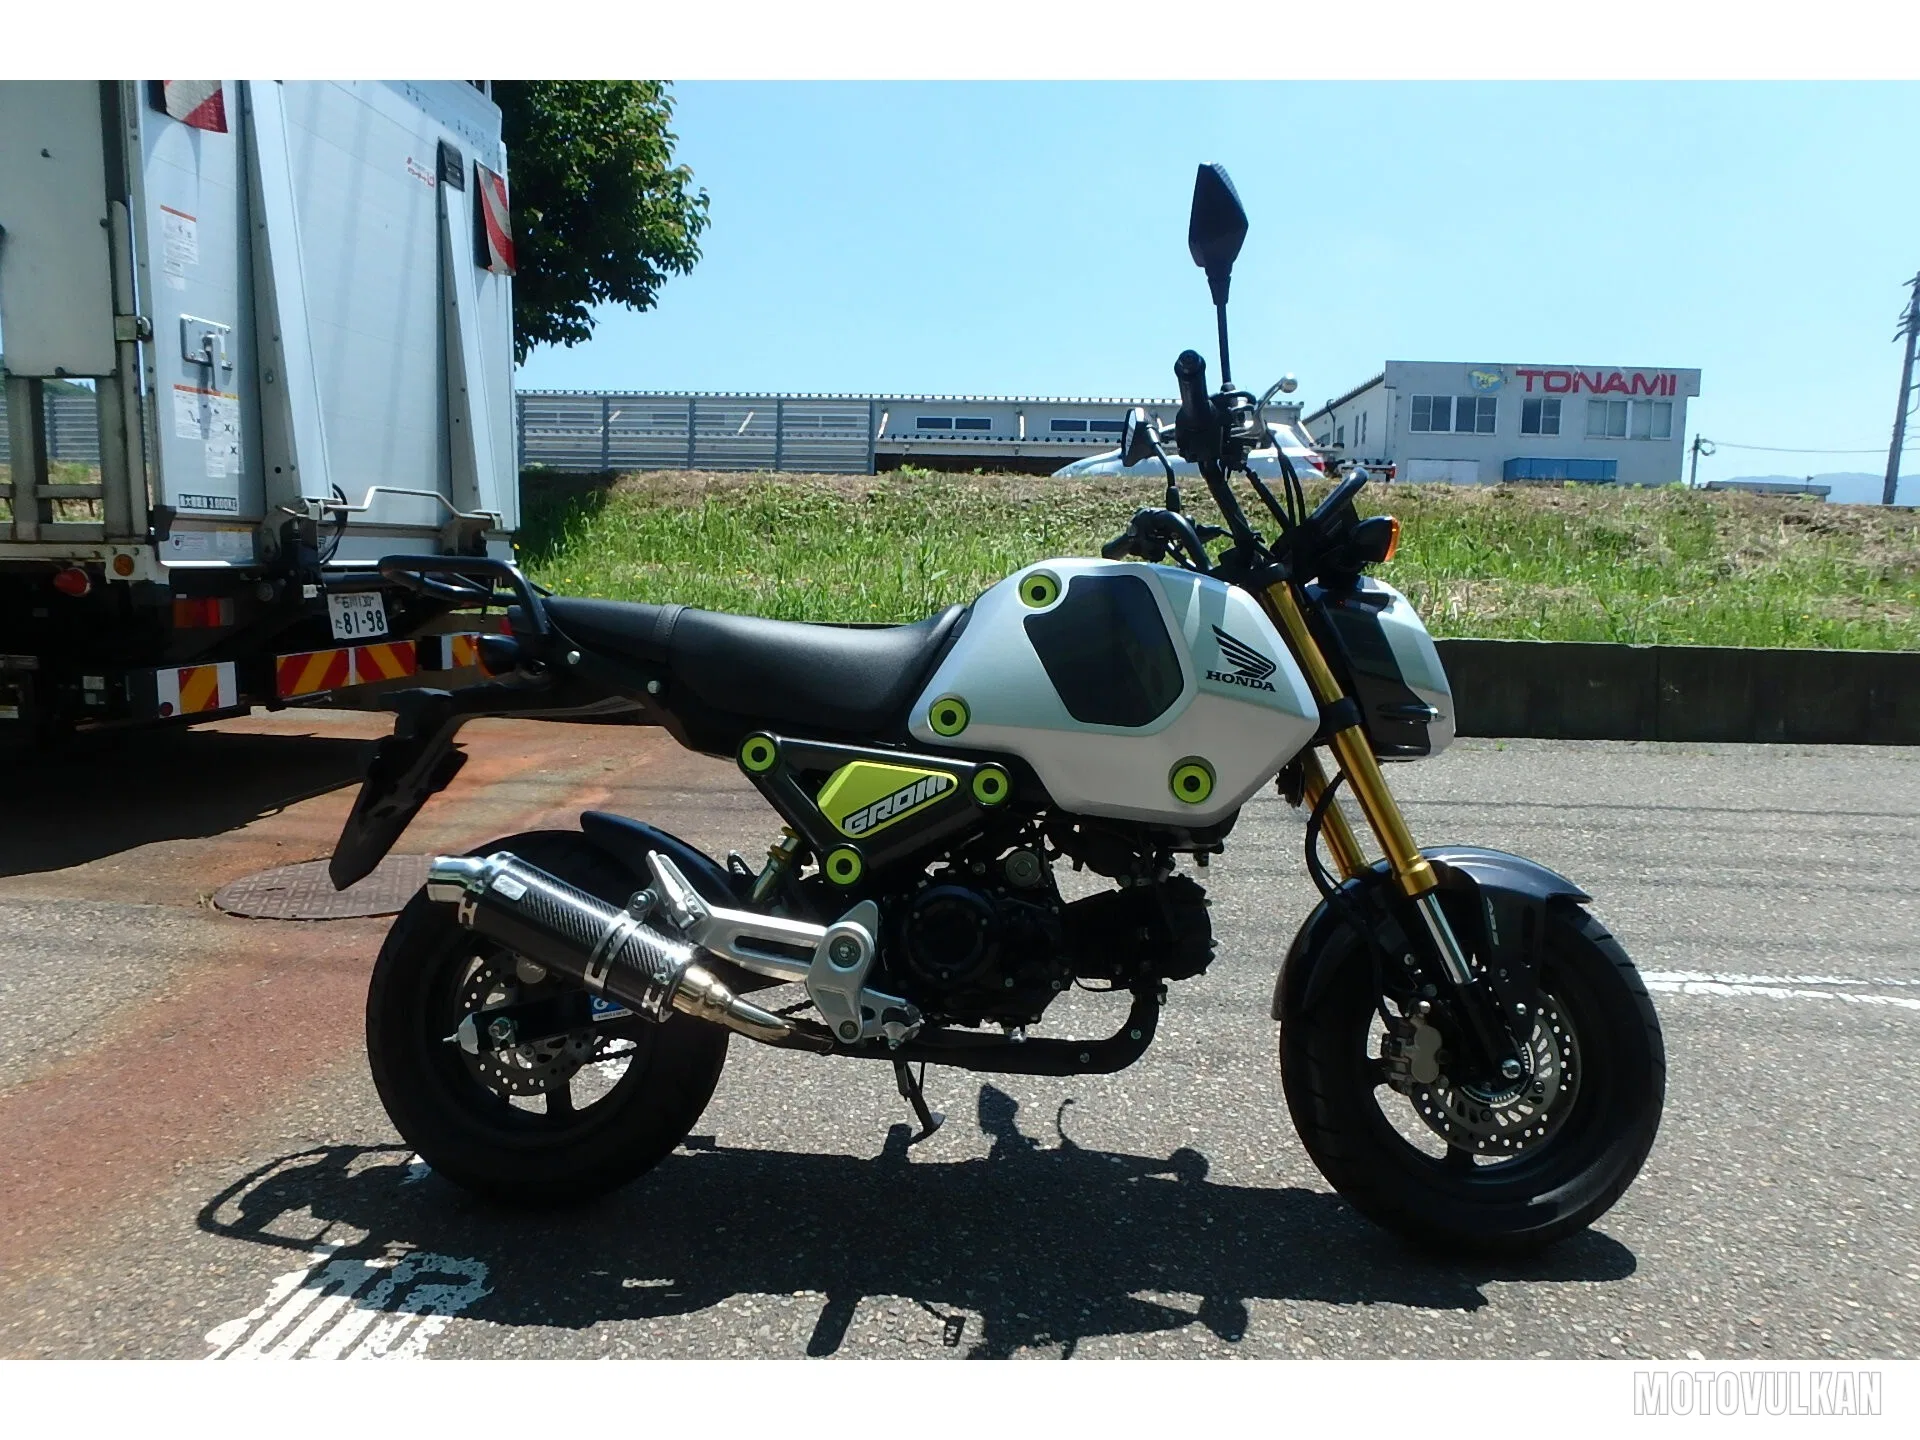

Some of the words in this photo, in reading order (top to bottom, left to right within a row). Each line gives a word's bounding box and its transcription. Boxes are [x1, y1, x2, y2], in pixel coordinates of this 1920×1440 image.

[1516, 369, 1677, 397] TONAMI
[343, 610, 384, 634] 81-98
[1206, 670, 1276, 692] HONDA
[844, 775, 948, 835] GROM
